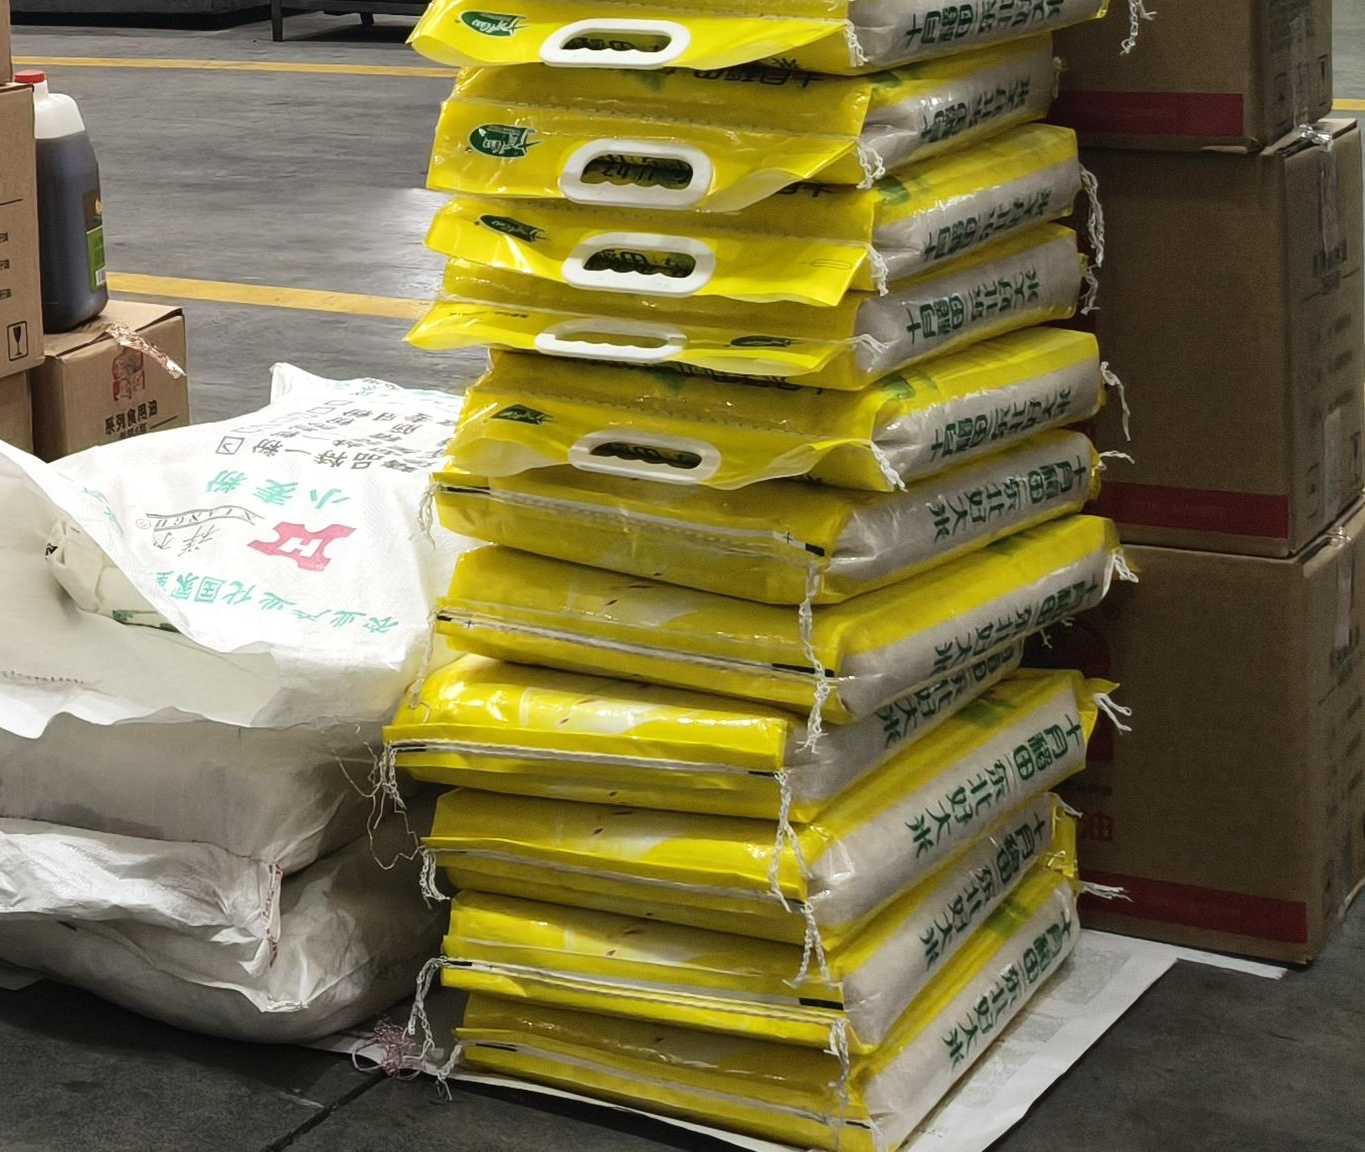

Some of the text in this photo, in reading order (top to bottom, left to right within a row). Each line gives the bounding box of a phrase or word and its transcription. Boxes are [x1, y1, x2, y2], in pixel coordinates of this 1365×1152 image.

[905, 3, 973, 47] 十月稻田
[923, 217, 977, 262] 十月稻田
[907, 268, 1039, 344] 十月稻田 东北好大米
[106, 400, 157, 435] 系列食用油
[991, 388, 1072, 441] 东北好大米
[204, 469, 350, 510] 小麦粉
[926, 455, 1086, 544] 十月稻田 东北好大米
[905, 714, 1082, 859] 十月稻田 东北好大米
[920, 811, 1045, 971] 十月稻田 东北好大米
[942, 910, 1072, 1068] 十月稻田 东北好大米
